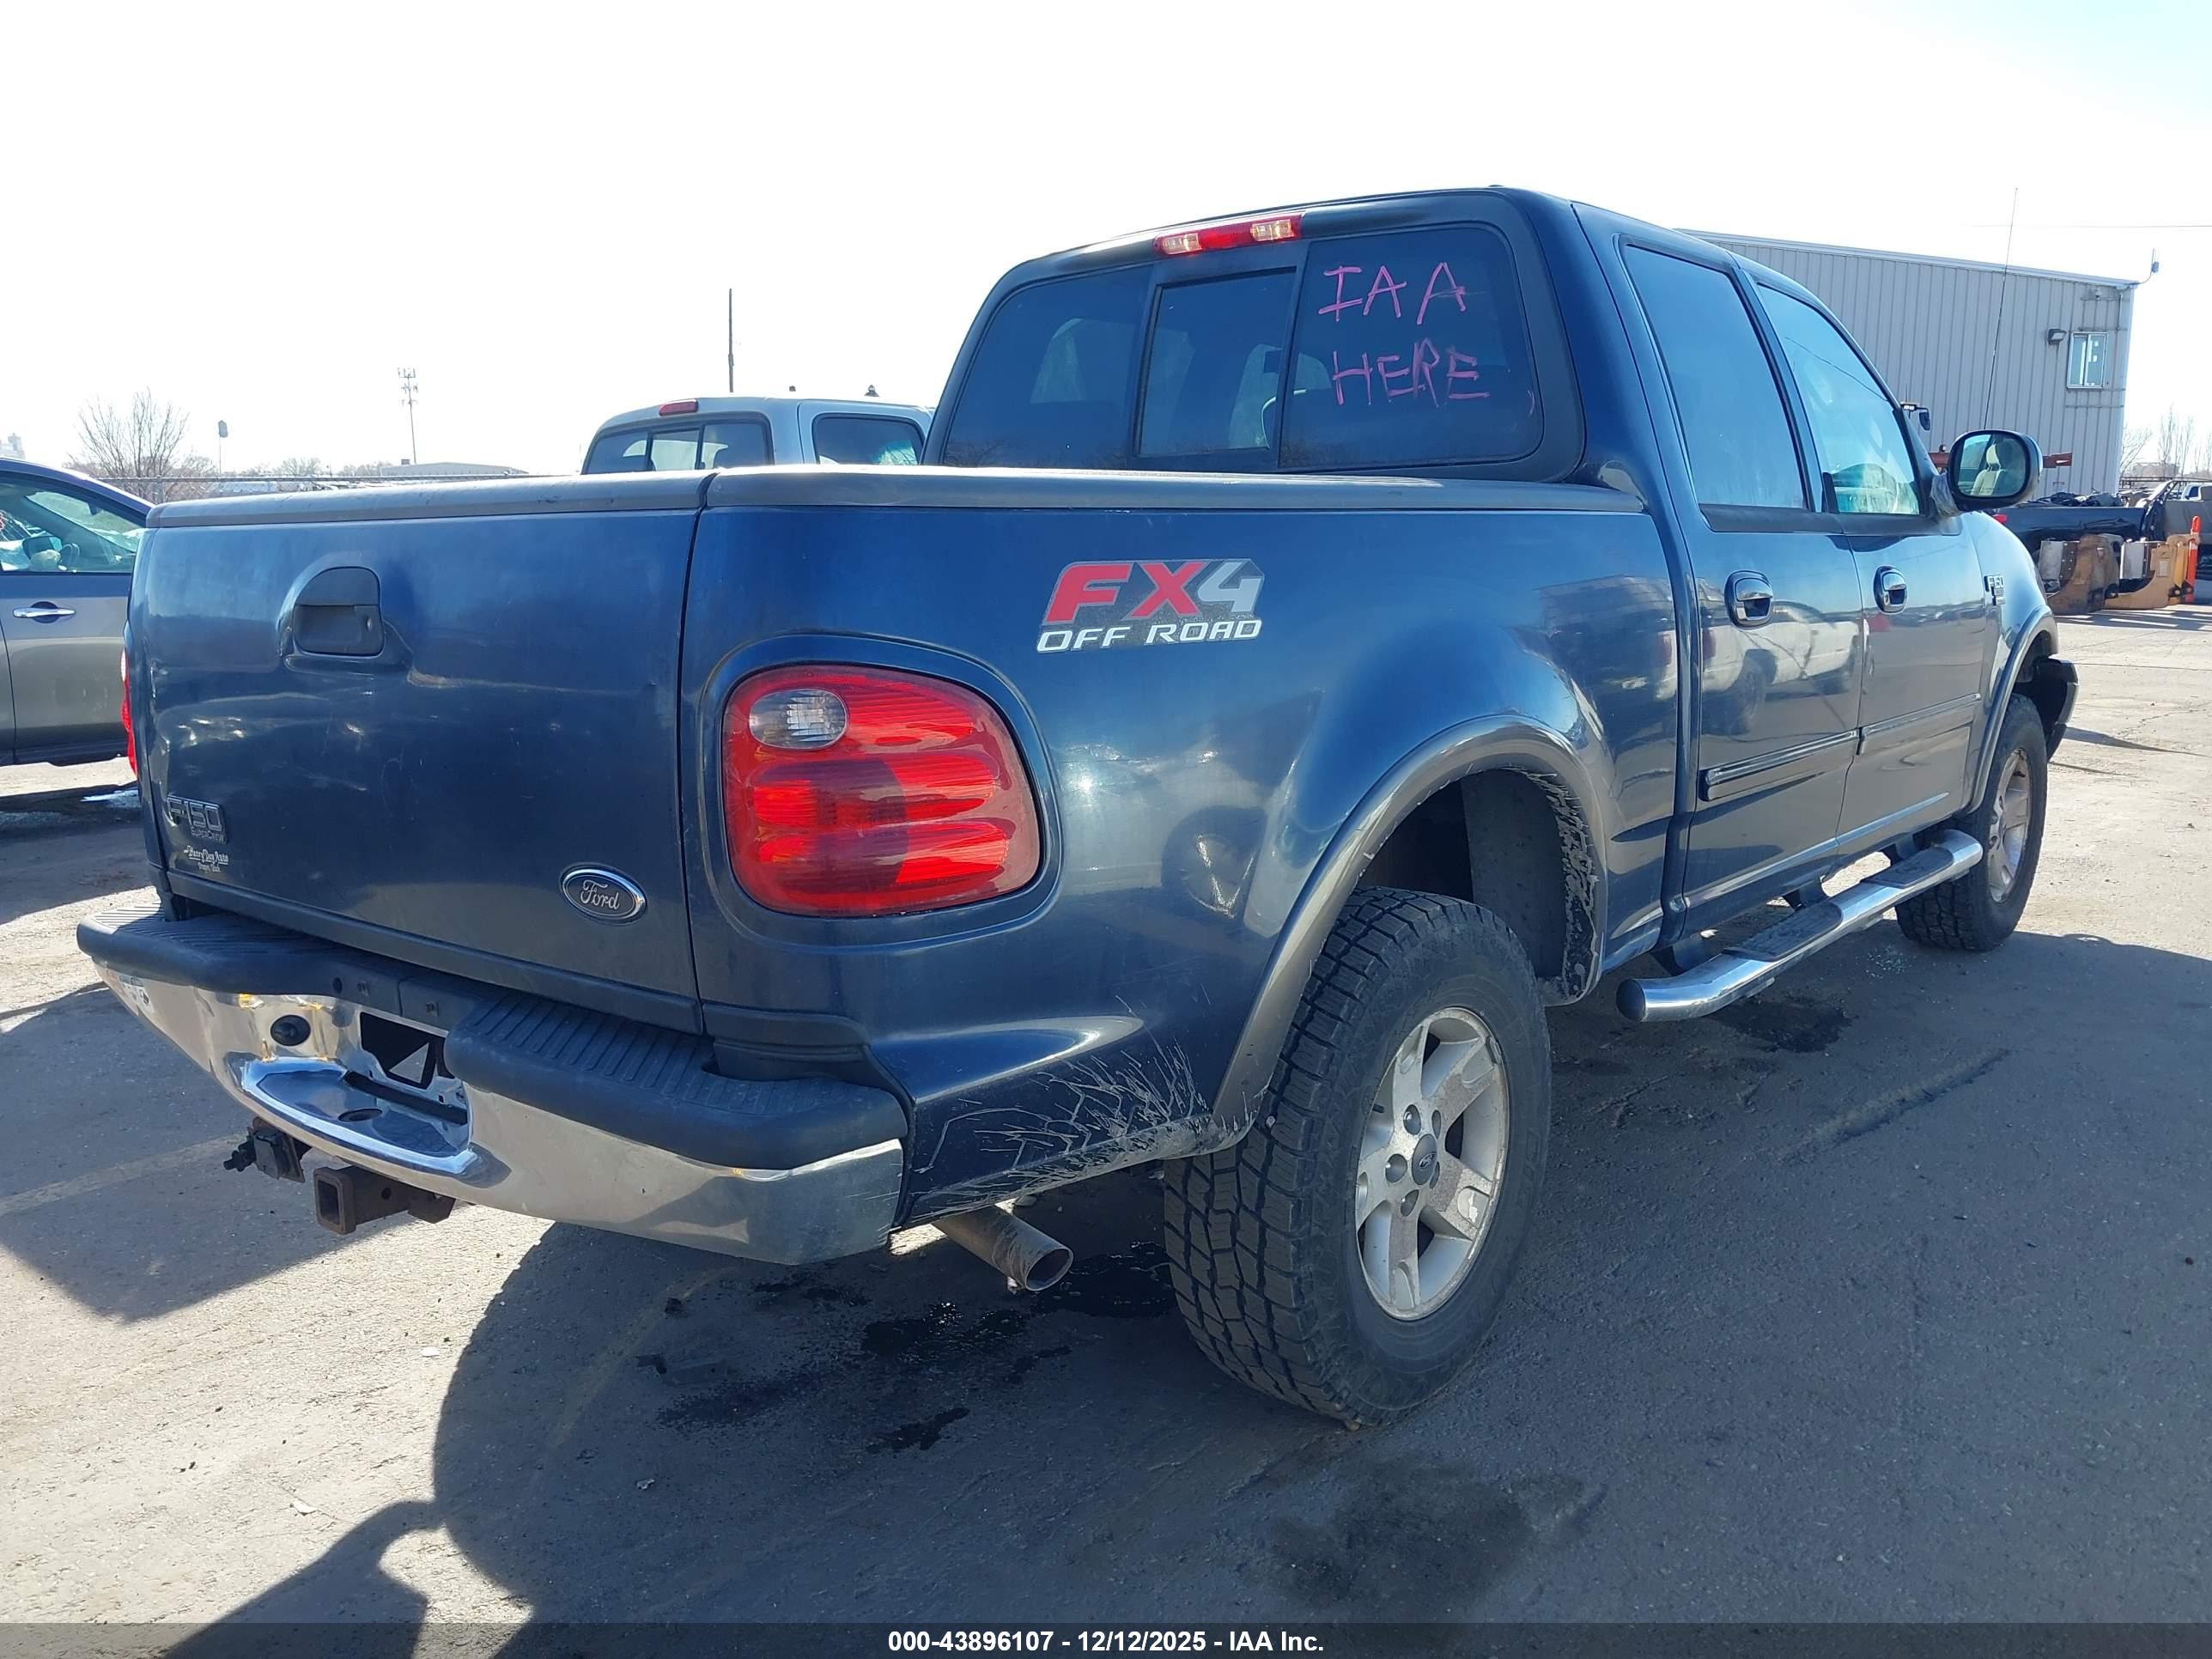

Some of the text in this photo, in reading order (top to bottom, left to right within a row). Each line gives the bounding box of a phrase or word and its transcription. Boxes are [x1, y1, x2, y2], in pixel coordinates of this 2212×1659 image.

[1318, 261, 1467, 325] IAA
[1332, 337, 1491, 409] HERE
[1042, 561, 1265, 625] FX4
[1036, 618, 1262, 653] OFF ROAD
[167, 797, 222, 832] F-150
[580, 879, 620, 910] Ford
